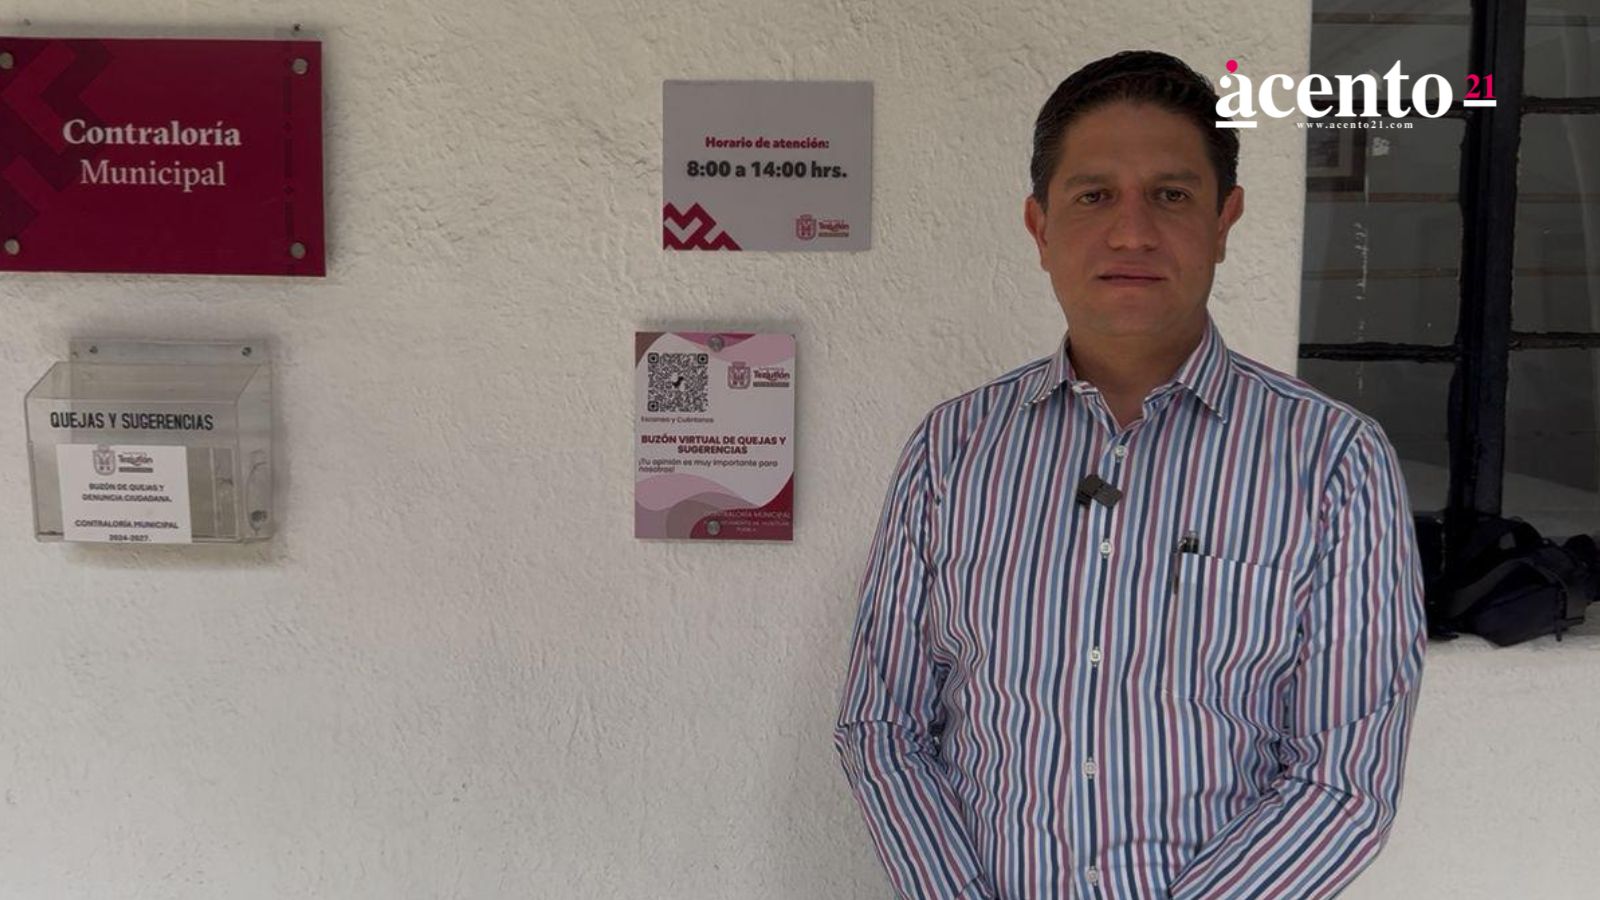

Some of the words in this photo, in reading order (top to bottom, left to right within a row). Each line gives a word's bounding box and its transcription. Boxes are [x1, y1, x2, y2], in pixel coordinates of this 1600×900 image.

[62, 119, 242, 146] Contraloría
[705, 136, 753, 149] Horario
[755, 137, 771, 149] de
[773, 137, 830, 149] atención:
[80, 158, 227, 193] Municipal
[686, 160, 731, 178] 8:00
[735, 164, 746, 178] a
[751, 161, 807, 179] 14:00
[811, 160, 848, 179] hrs.
[50, 411, 105, 429] QUEJAS
[108, 412, 117, 429] Y
[122, 412, 214, 431] SUGERENCIAS
[641, 434, 677, 444] BUZÓN
[679, 435, 721, 445] VIRTUAL
[722, 436, 736, 445] DE
[737, 436, 778, 446] QUEJAS
[779, 436, 787, 446] Y
[677, 445, 748, 455] SUGERENCIAS
[652, 458, 682, 467] opinión
[682, 459, 693, 467] es
[694, 460, 711, 468] muy
[713, 459, 757, 468] importante
[758, 461, 778, 469] para
[88, 482, 116, 491] BUZÓN
[116, 483, 128, 492] DE
[129, 484, 158, 492] QUEJAS
[81, 493, 123, 502] DENUNCIA
[74, 518, 132, 528] CONTRALORÍA
[133, 520, 180, 530] MUNICIPAL
